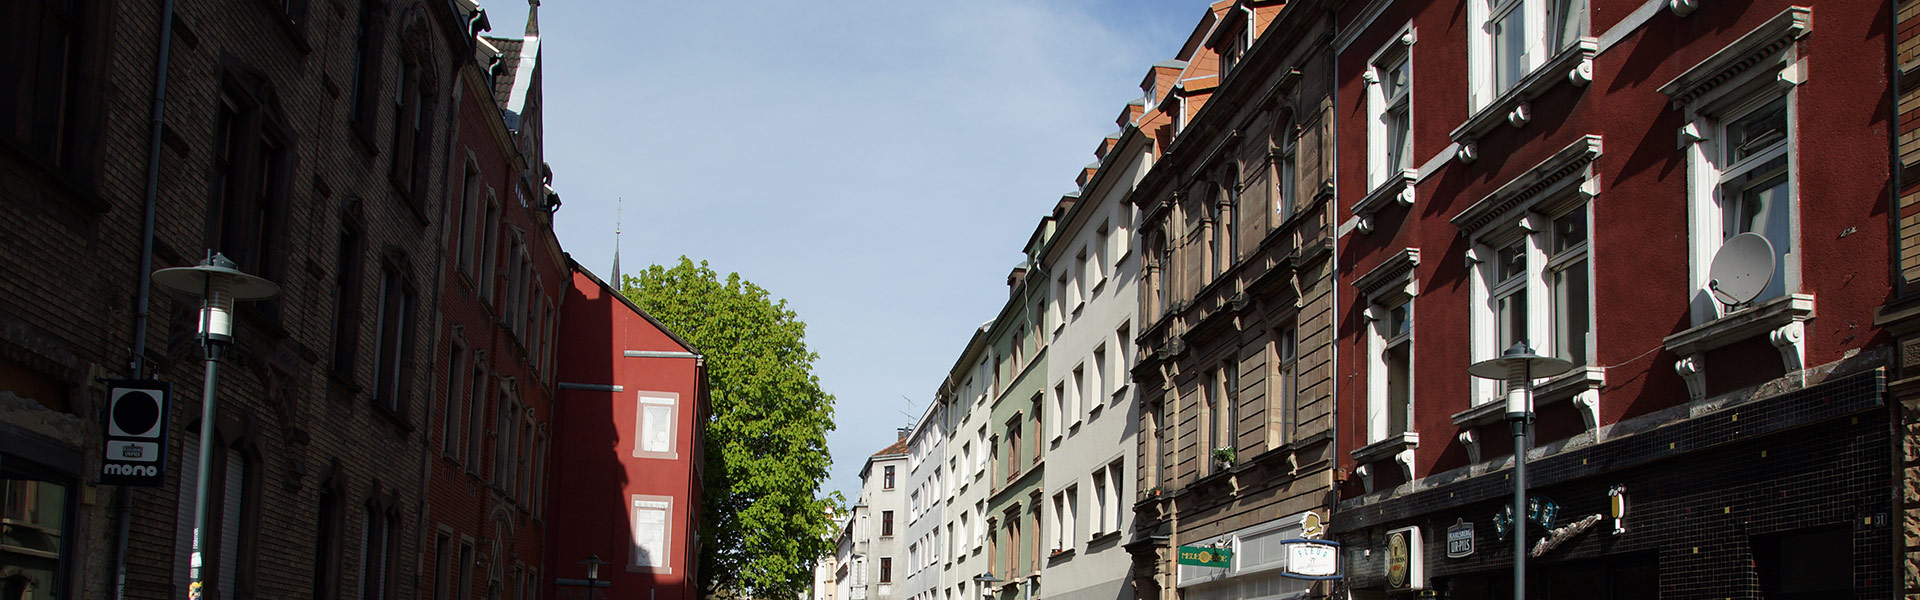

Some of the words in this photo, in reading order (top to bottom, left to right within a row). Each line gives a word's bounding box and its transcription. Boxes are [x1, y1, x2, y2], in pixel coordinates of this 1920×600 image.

[103, 464, 158, 476] mono
[1875, 514, 1884, 524] 31
[1297, 546, 1328, 558] FLEUR
